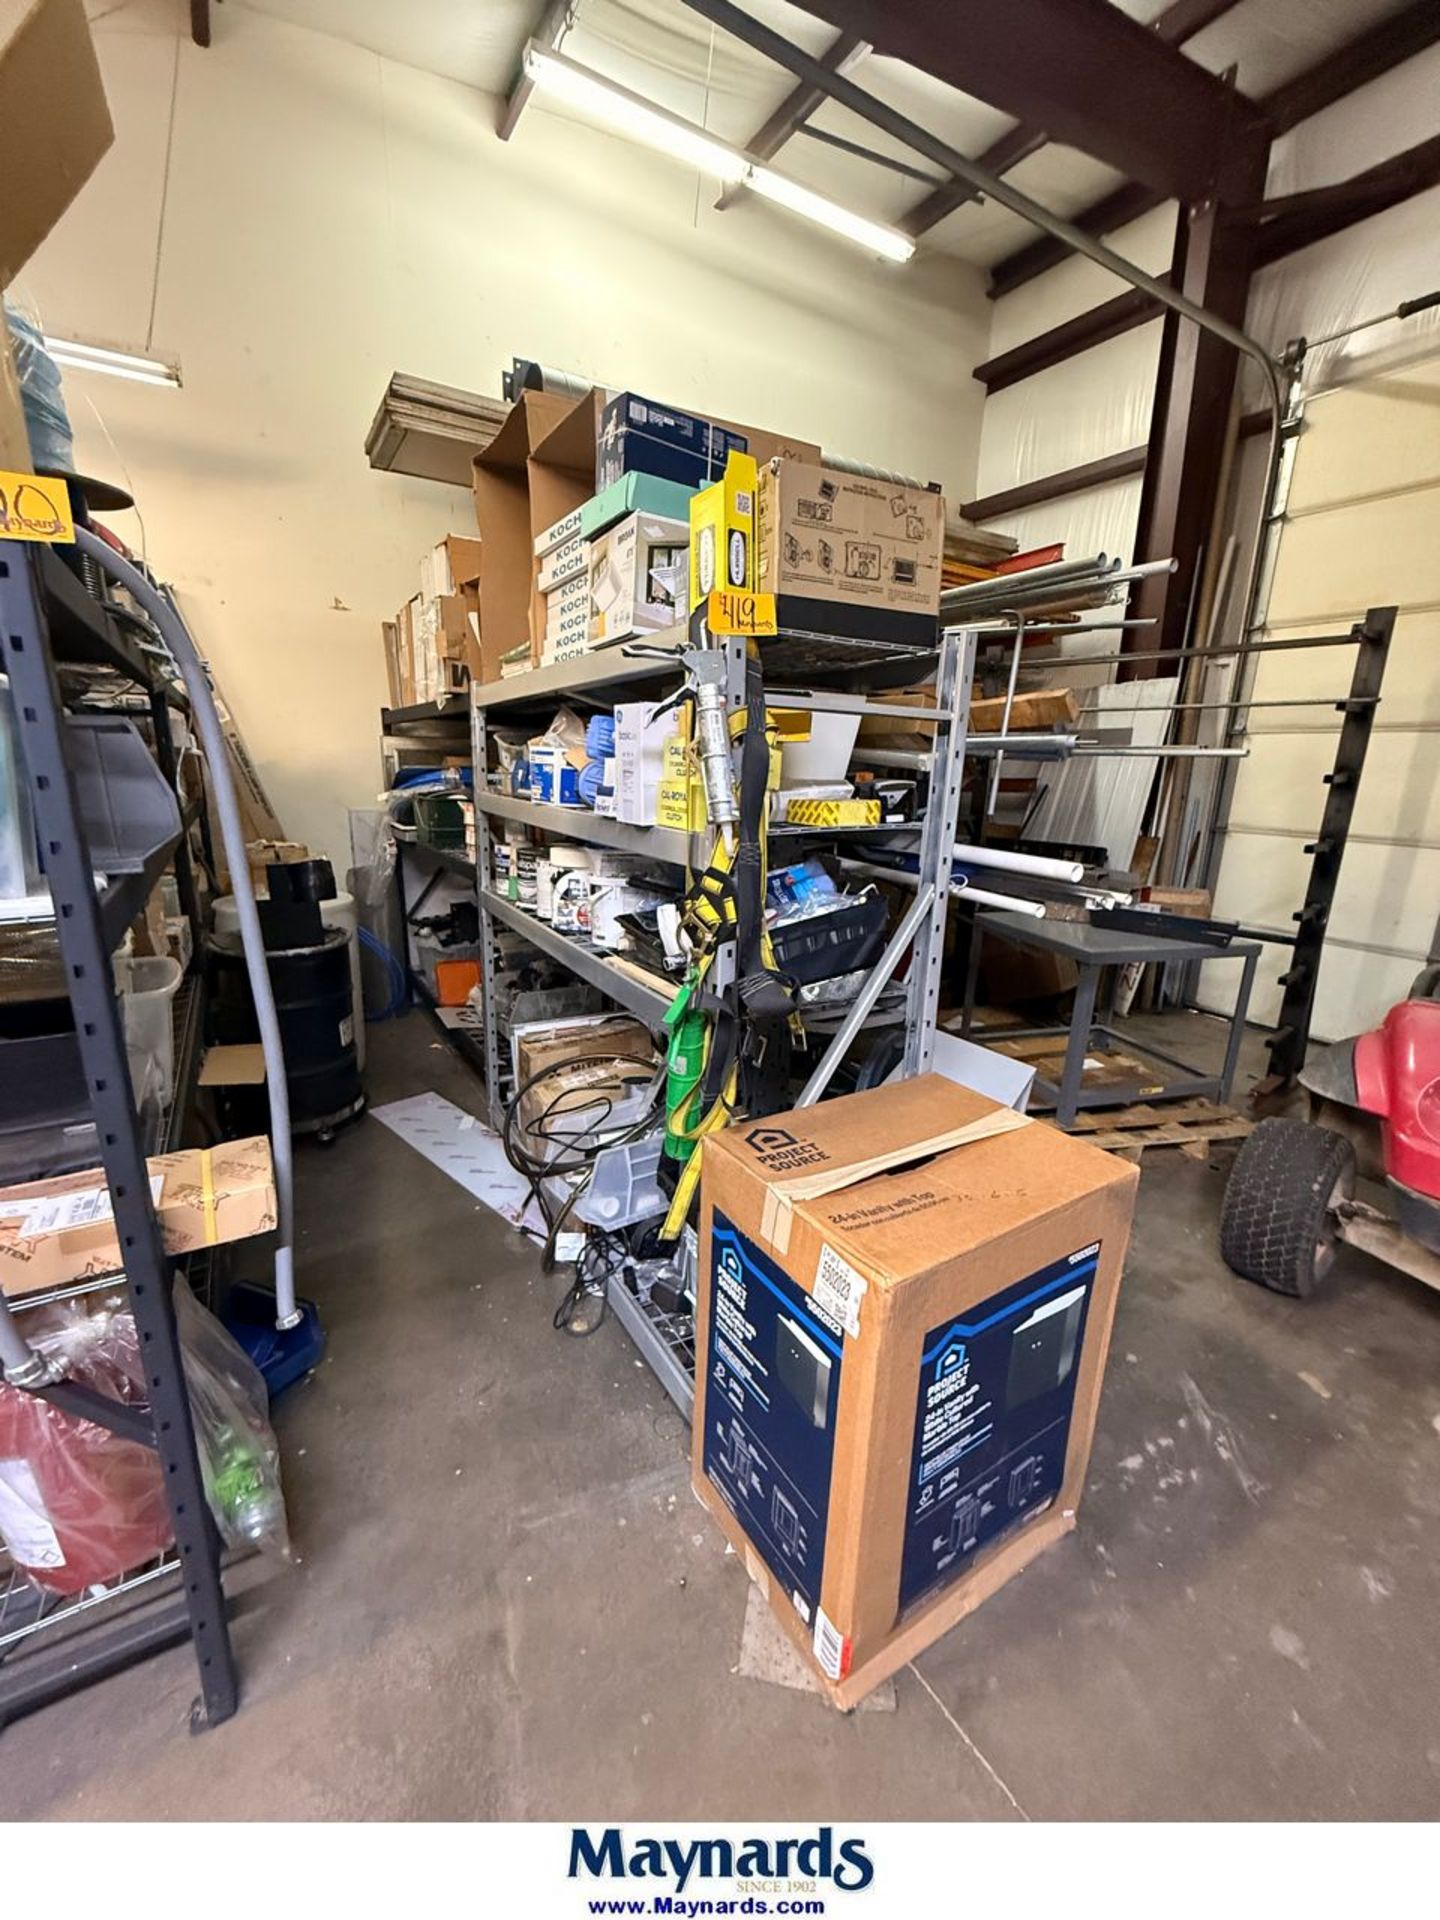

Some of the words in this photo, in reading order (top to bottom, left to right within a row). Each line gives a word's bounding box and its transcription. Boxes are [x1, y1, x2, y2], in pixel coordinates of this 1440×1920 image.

[550, 512, 582, 541] KOCH
[552, 554, 583, 580] KOCH
[556, 630, 585, 649] KOCH
[554, 647, 584, 664] KOCH
[756, 1142, 820, 1165] PROJECT
[768, 1151, 832, 1172] SOURCE
[858, 1202, 894, 1219] Vanity
[893, 1194, 915, 1210] with
[912, 1191, 936, 1203] Top
[927, 1375, 967, 1408] SOURCE
[928, 1363, 970, 1398] PROJECT
